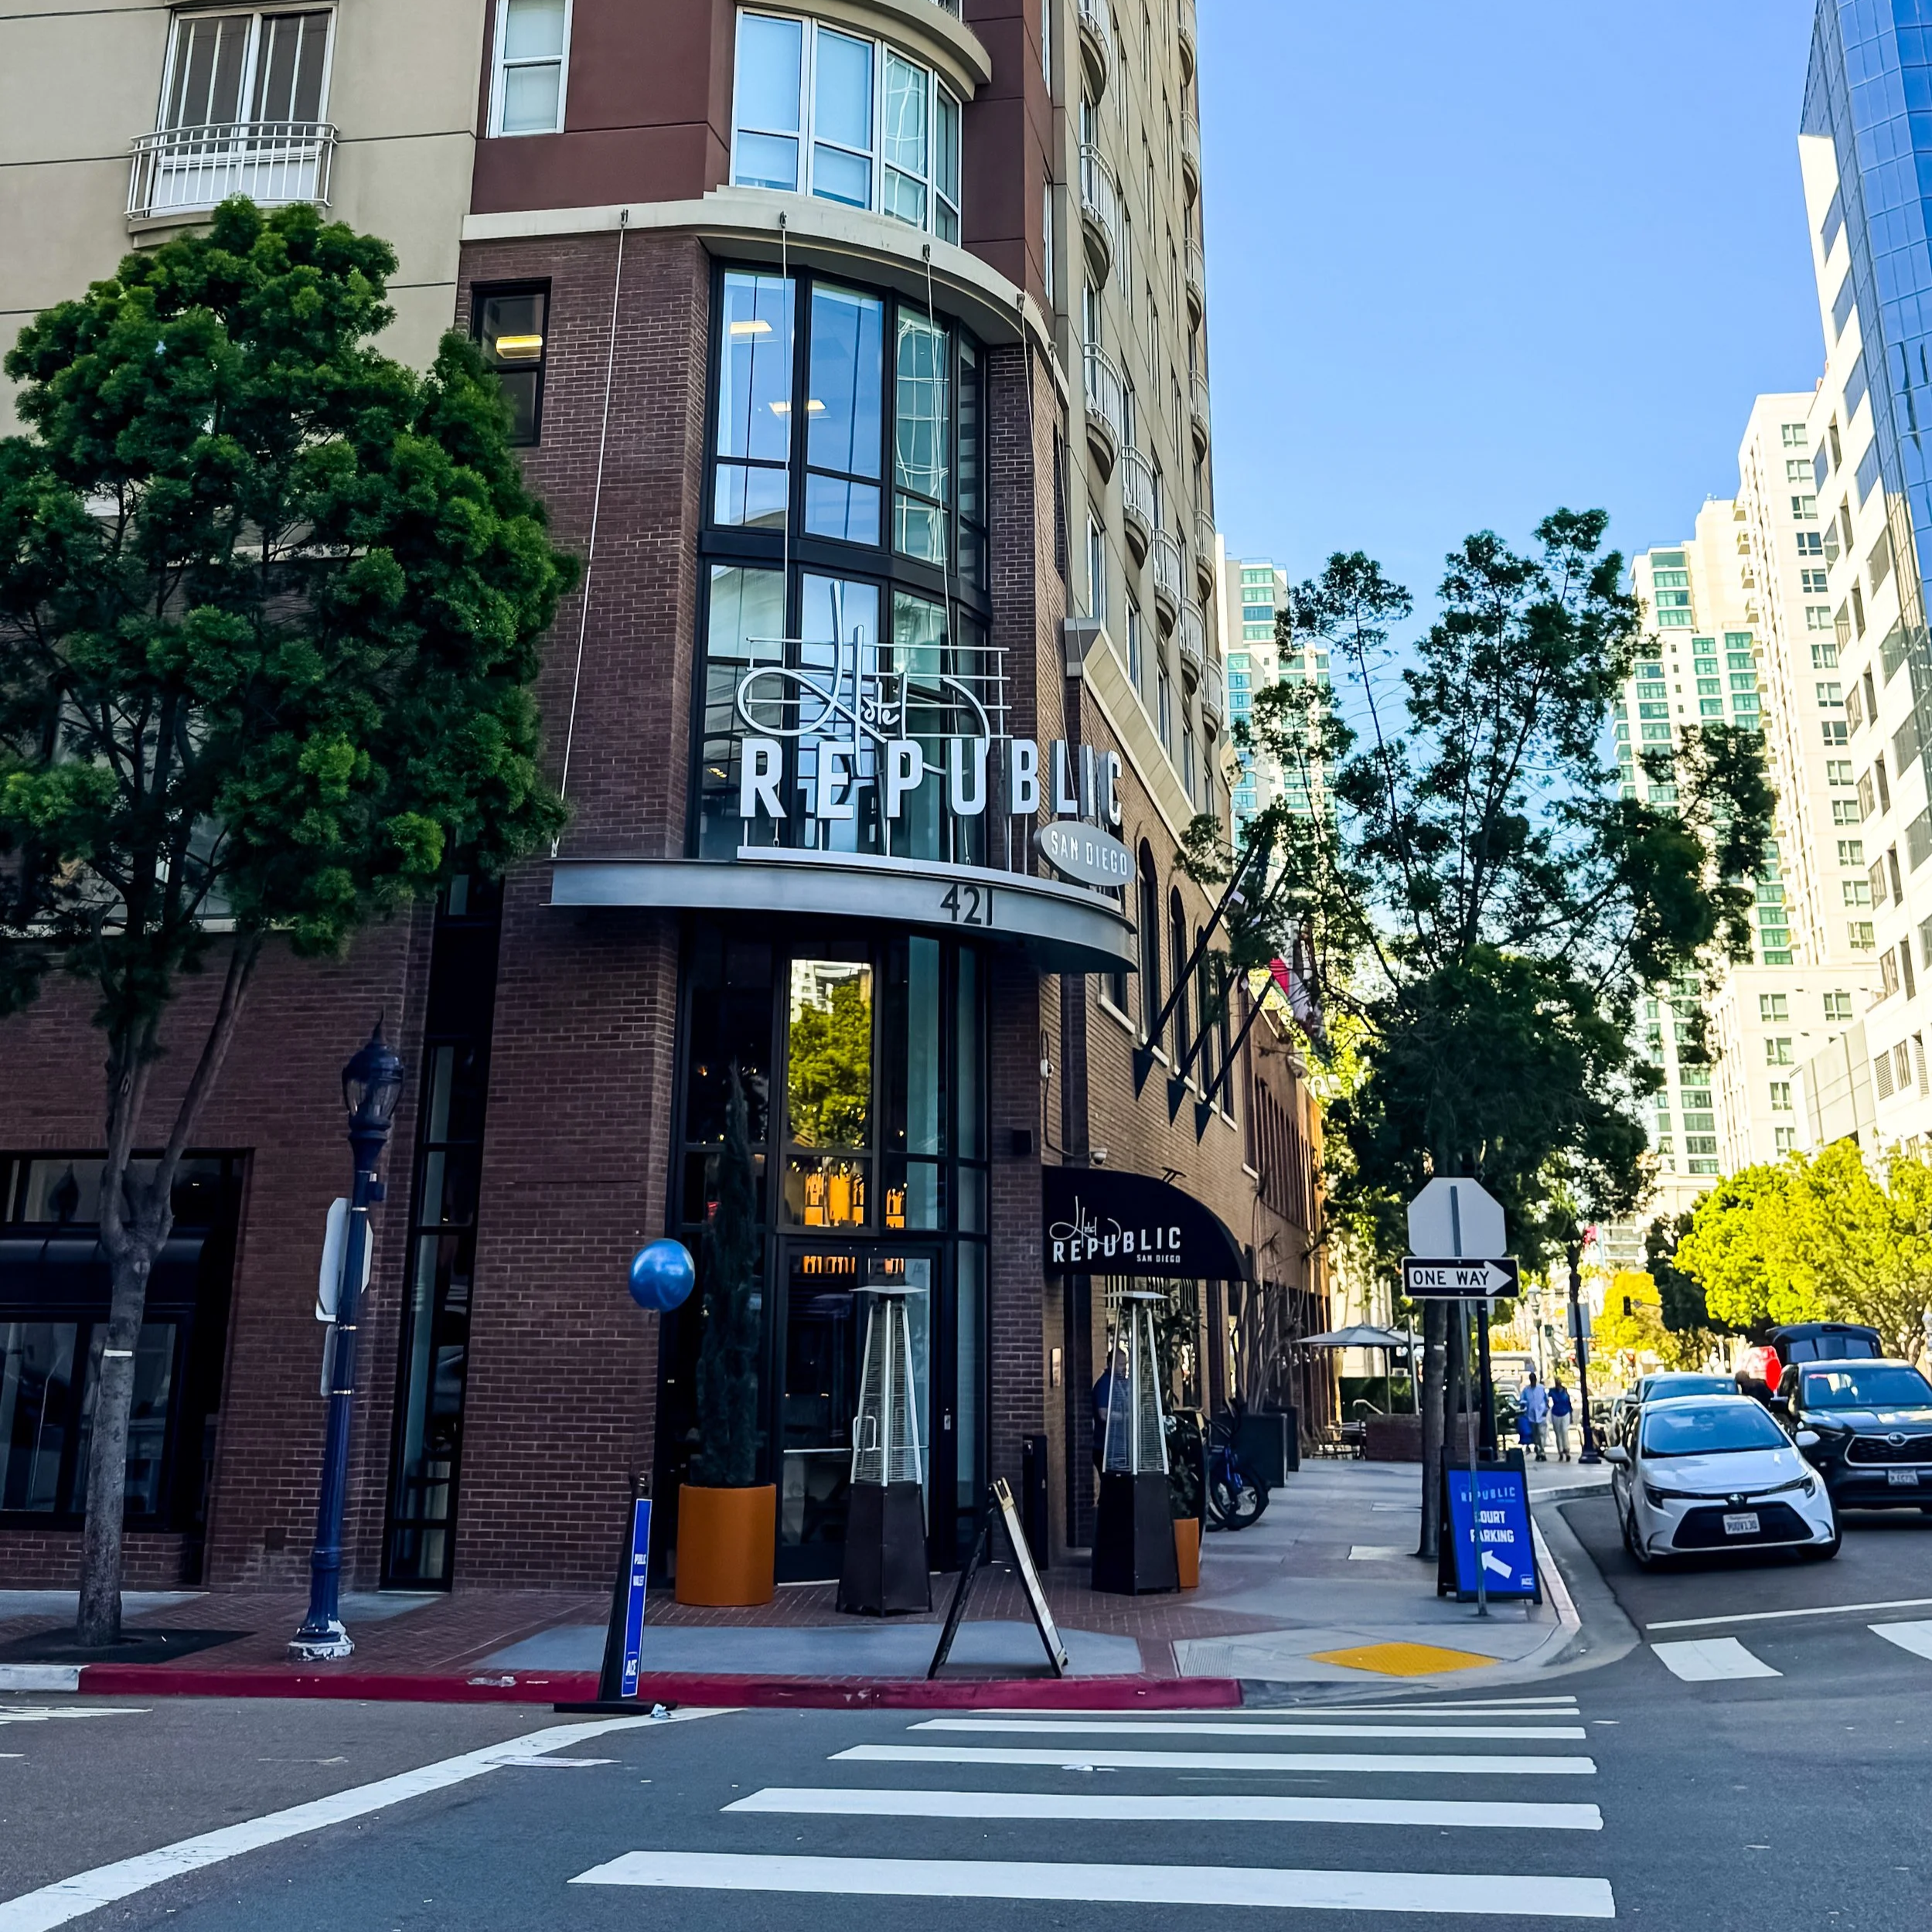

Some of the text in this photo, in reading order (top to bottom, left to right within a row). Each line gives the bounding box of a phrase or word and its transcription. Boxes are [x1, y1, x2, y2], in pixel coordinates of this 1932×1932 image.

[738, 580, 990, 775] Hotel
[740, 738, 1122, 826] REPUBLIC
[1051, 830, 1127, 876] SAN DIEGO
[940, 885, 993, 926] 421
[1053, 1227, 1181, 1262] REPUBLIC
[1136, 1254, 1181, 1263] SAN DIEGO
[1413, 1270, 1489, 1286] ONE WAY
